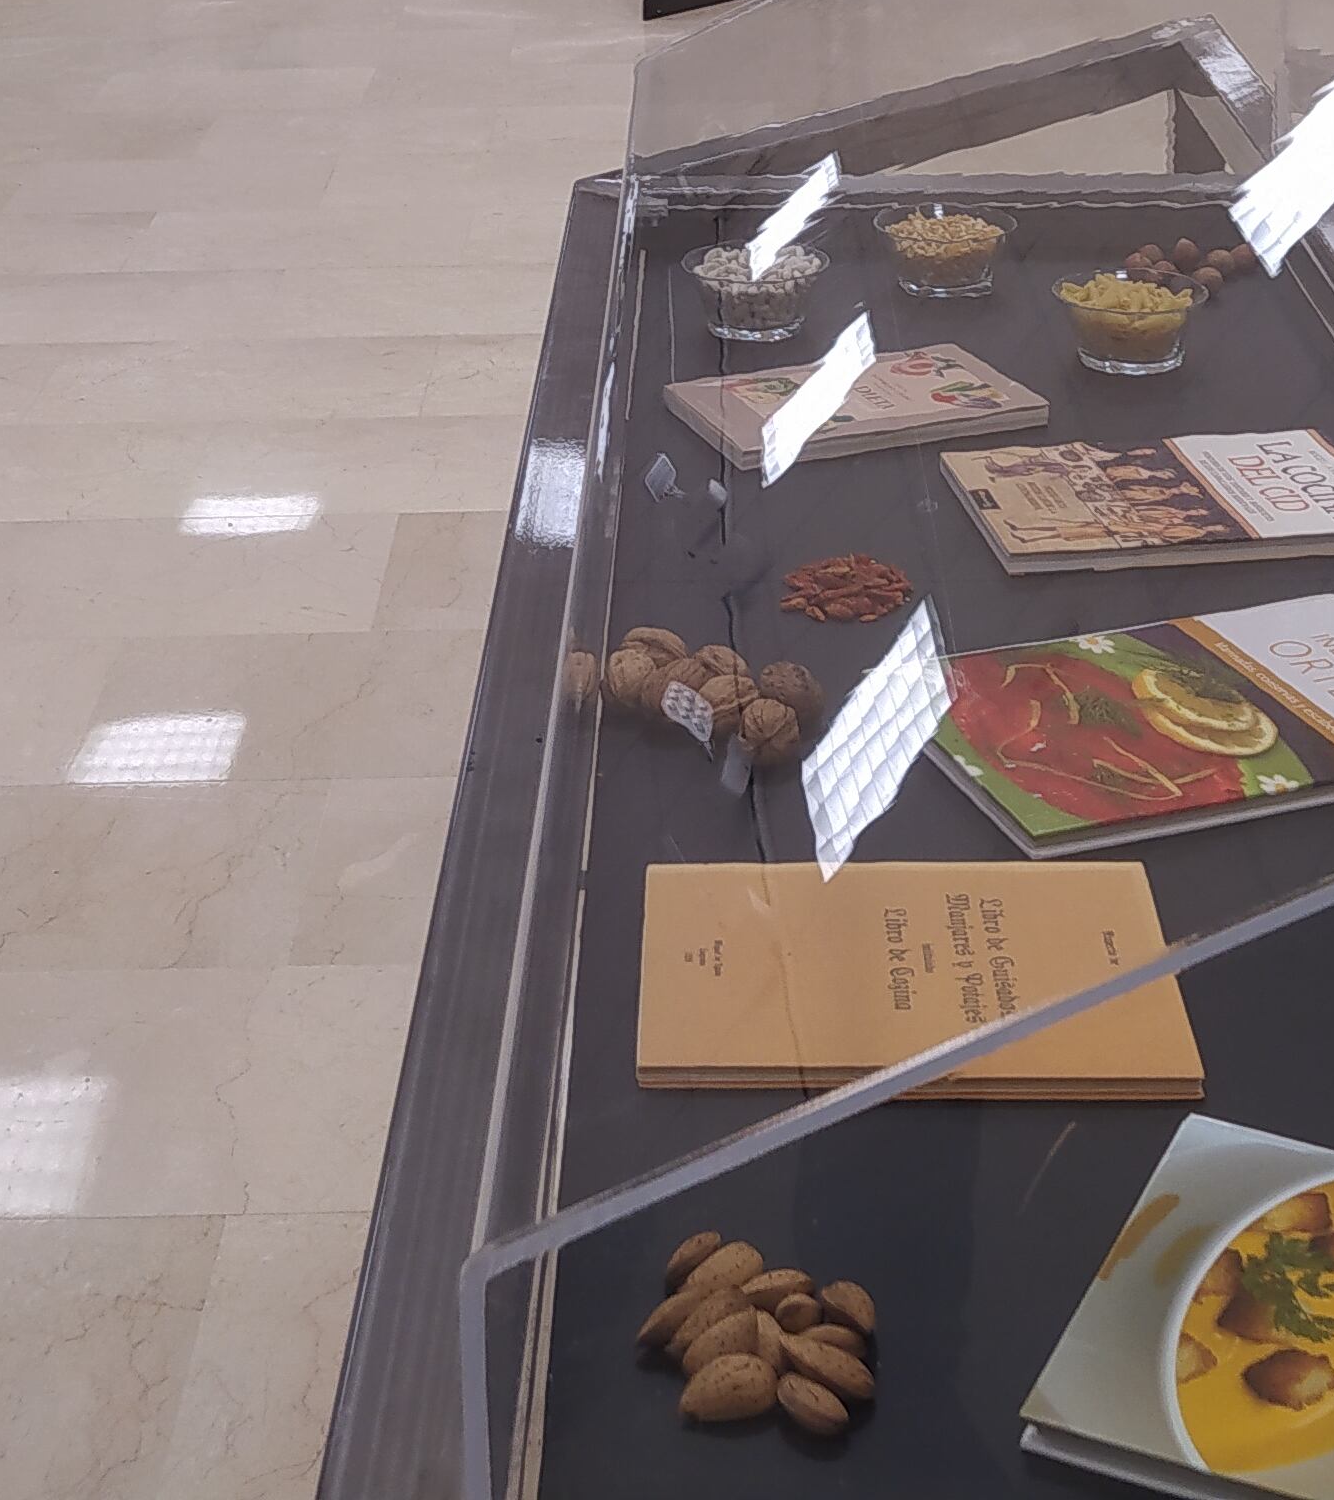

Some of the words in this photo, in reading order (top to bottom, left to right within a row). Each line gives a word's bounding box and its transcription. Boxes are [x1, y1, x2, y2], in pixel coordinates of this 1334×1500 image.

[1256, 441, 1302, 464] LA
[1227, 455, 1284, 487] DEL
[1258, 486, 1310, 512] CID
[883, 907, 908, 943] Libro
[945, 893, 975, 957] Manjares
[979, 898, 1004, 934] Libro
[889, 948, 909, 963] de
[985, 936, 1010, 953] de
